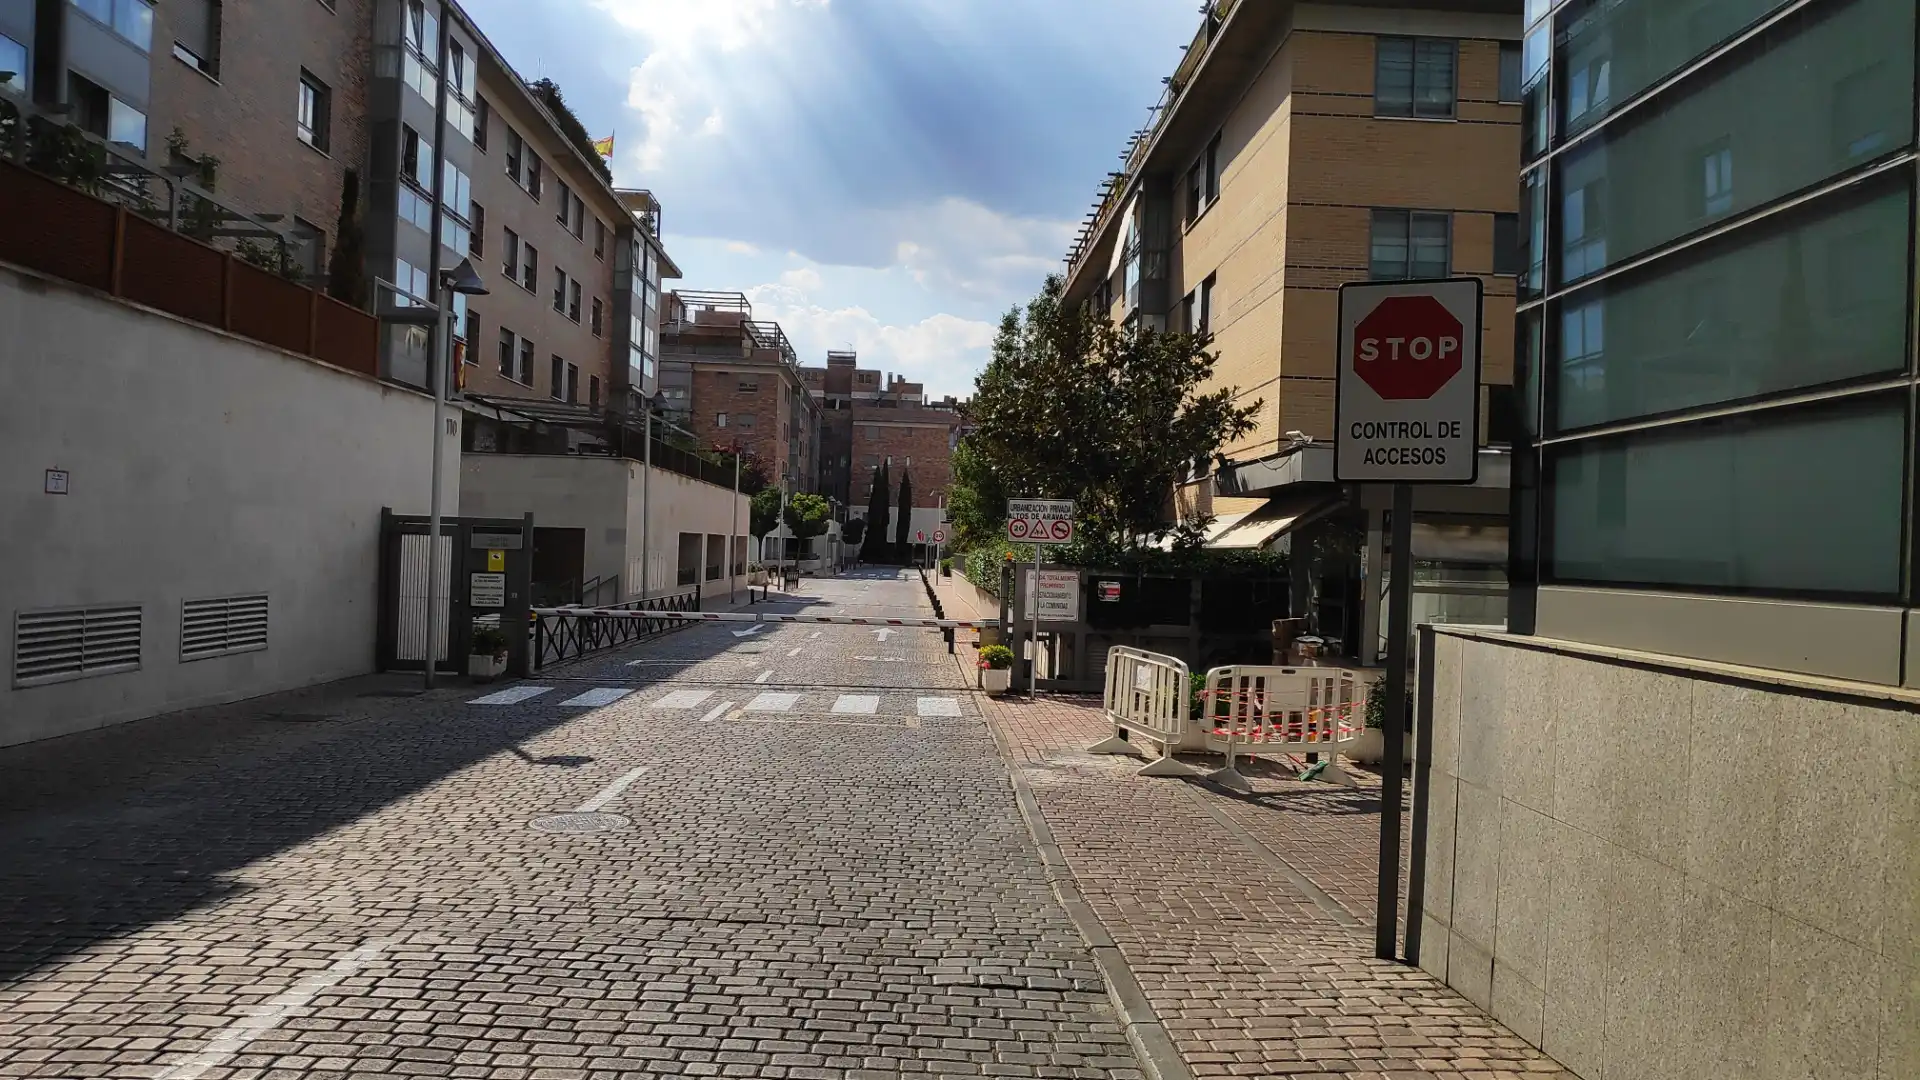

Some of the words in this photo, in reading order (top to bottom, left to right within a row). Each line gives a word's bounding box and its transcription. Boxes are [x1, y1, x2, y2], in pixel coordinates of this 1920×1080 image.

[1359, 336, 1458, 361] STOP
[446, 418, 457, 436] 110
[1351, 421, 1432, 439] CONTROL
[1437, 421, 1461, 438] DE
[1363, 447, 1446, 465] ACCESOS
[1042, 513, 1073, 521] ARAVACA
[1050, 505, 1071, 513] PRIVADA
